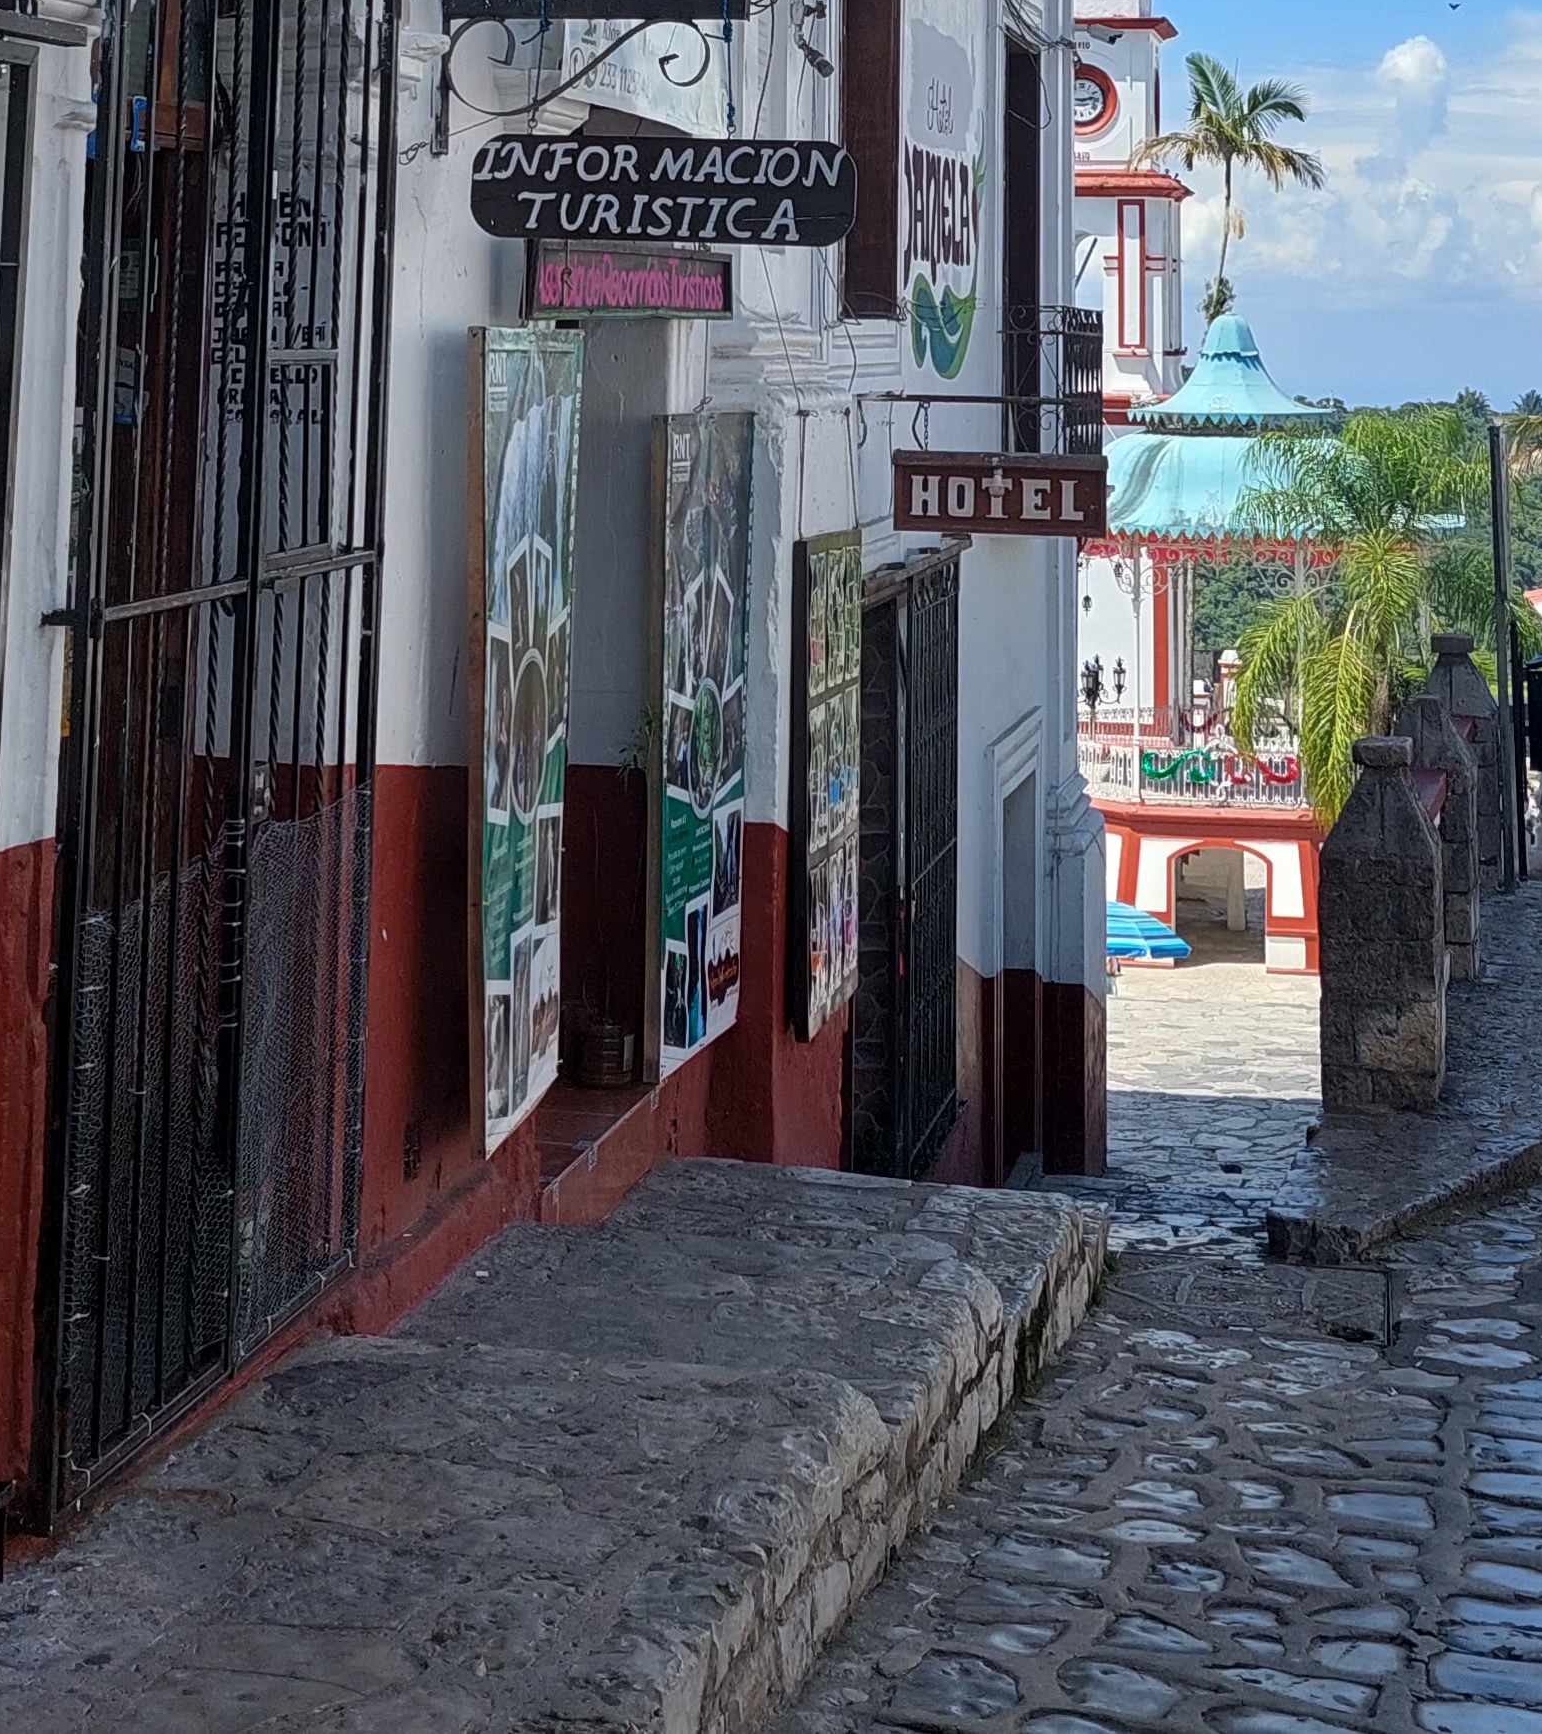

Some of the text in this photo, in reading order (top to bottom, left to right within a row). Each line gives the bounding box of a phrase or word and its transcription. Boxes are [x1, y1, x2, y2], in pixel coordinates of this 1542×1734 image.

[517, 191, 800, 242] TURISTICA
[672, 433, 691, 460] RNT
[909, 474, 1085, 521] HOTEL
